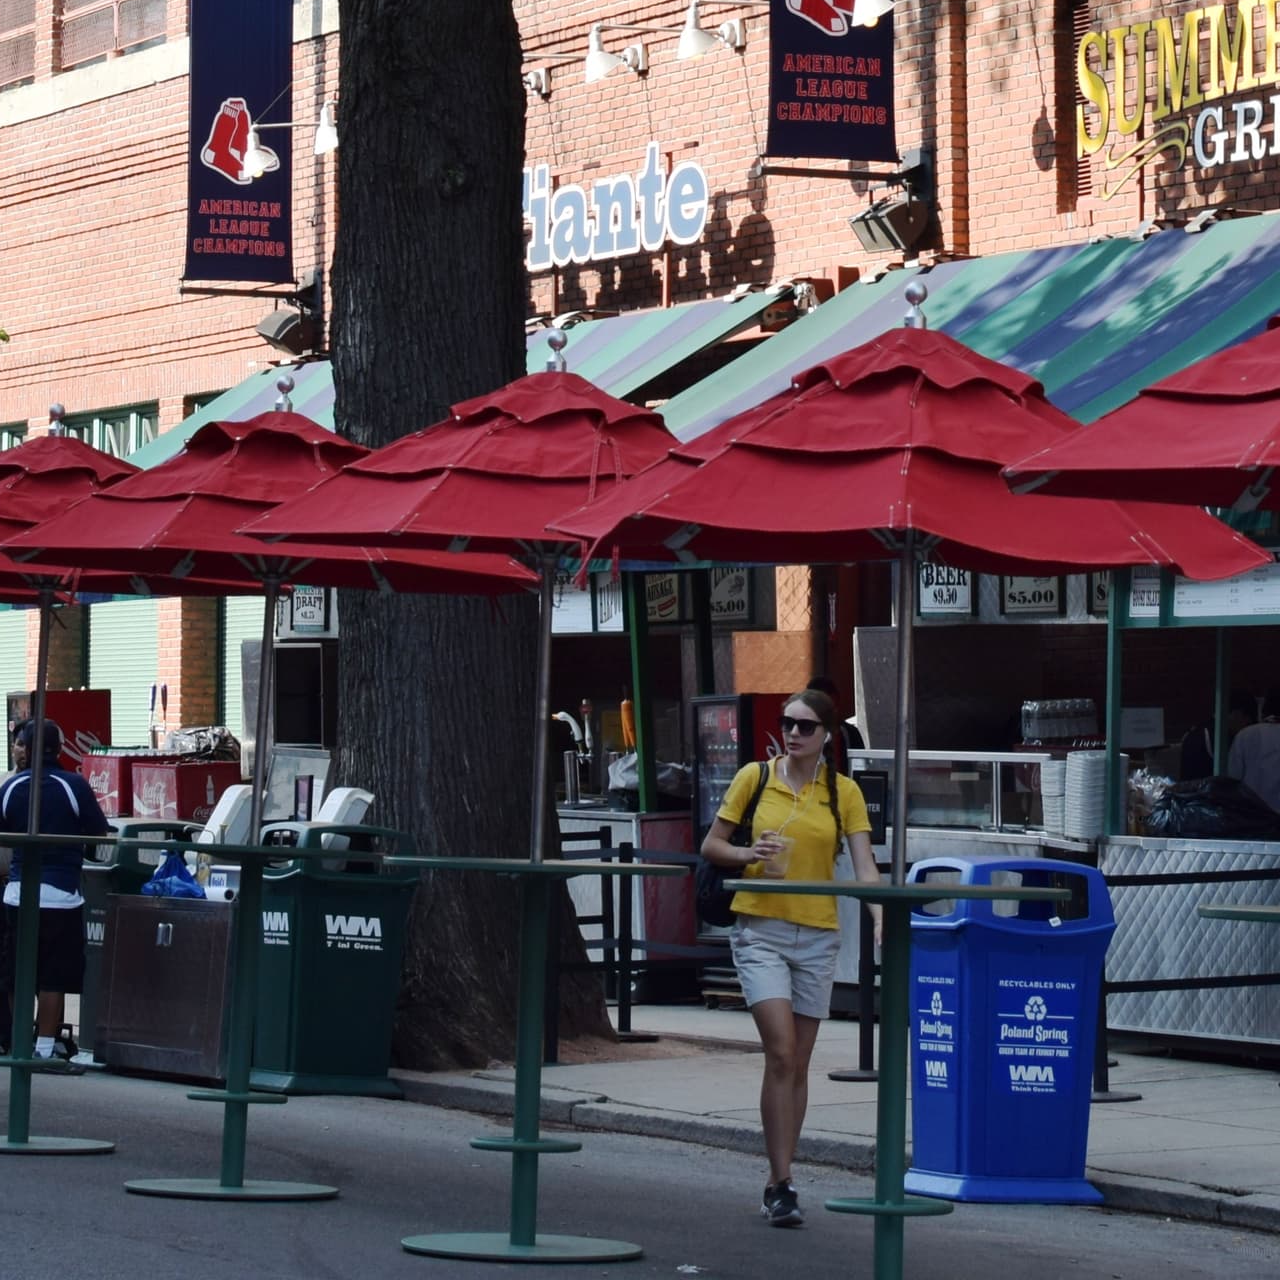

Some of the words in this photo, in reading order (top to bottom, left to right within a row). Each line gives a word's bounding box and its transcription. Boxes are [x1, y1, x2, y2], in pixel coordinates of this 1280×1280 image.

[783, 53, 881, 77] AMERICAN
[796, 78, 868, 99] LEAGUE
[776, 102, 887, 125] CHAMPIONS
[198, 199, 281, 218] AMERICAN
[523, 140, 709, 271] iante
[209, 218, 270, 237] LEAGUE
[193, 238, 285, 257] CHAMPIONS
[923, 562, 967, 589] BEER
[296, 596, 323, 611] DRAFT
[932, 588, 958, 605] $9.50
[1007, 589, 1055, 604] $5.00
[866, 803, 880, 813] TER
[262, 911, 289, 932] WM
[325, 914, 382, 937] WM
[999, 979, 1054, 989] RECYCLABLES
[1055, 981, 1076, 990] ONLY
[920, 1019, 937, 1036] Poland
[937, 1020, 953, 1039] Spring
[1000, 1023, 1034, 1041] Poland
[1035, 1025, 1068, 1044] Spring
[999, 1047, 1014, 1056] GREEN
[1014, 1048, 1028, 1056] TEAM
[1028, 1048, 1036, 1056] AT
[1055, 1049, 1069, 1058] PARK
[925, 1060, 948, 1077] WM
[1009, 1064, 1055, 1082] WM
